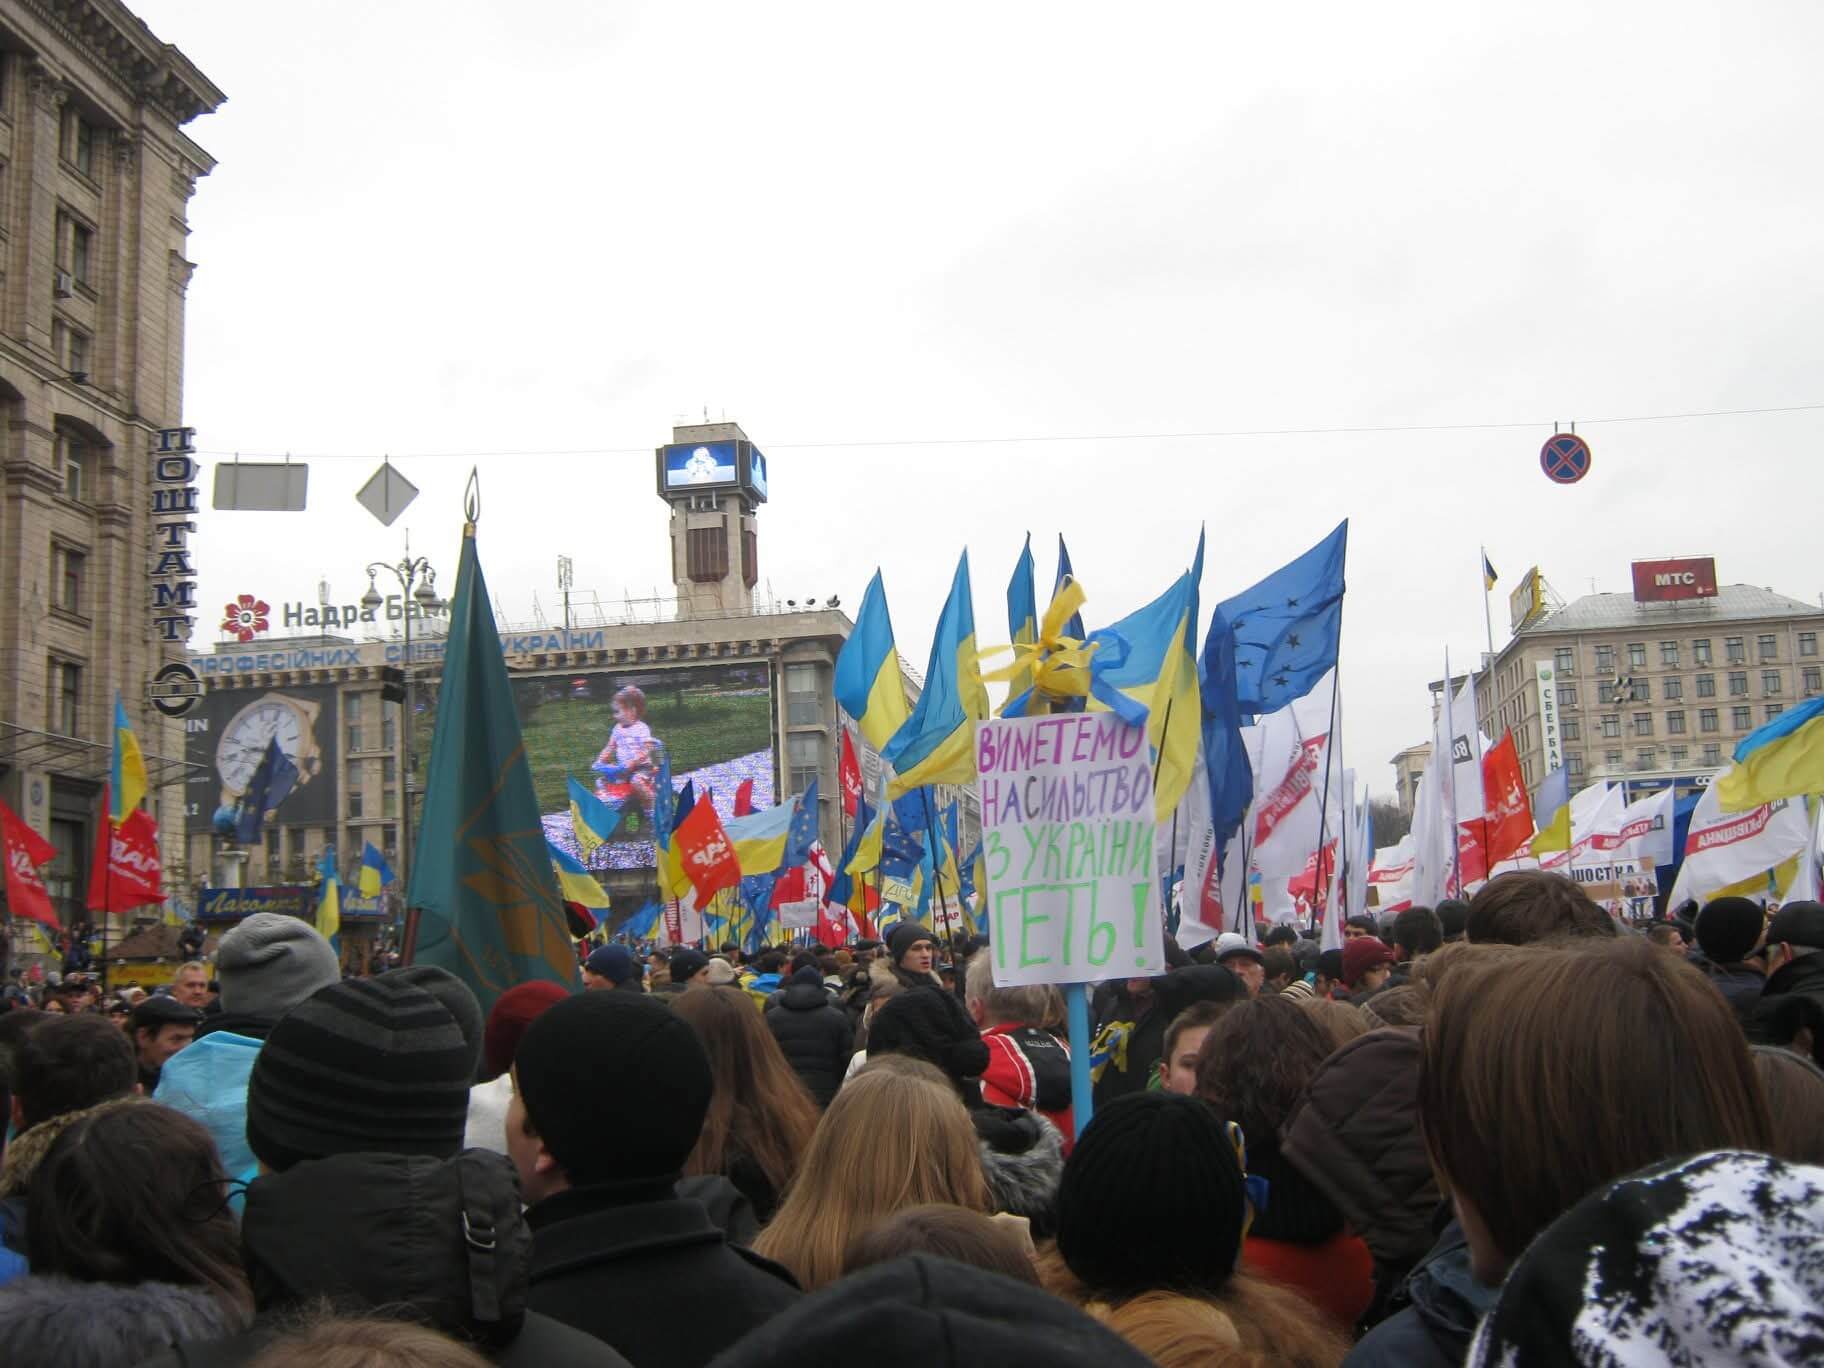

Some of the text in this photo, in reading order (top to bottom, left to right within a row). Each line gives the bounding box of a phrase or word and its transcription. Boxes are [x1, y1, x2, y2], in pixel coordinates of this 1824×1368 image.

[151, 426, 198, 642] ПОШТАМТ
[1655, 571, 1695, 587] МТС
[283, 601, 376, 629] Надра
[978, 717, 1146, 773] ВИМЕТЕМО
[982, 763, 1151, 827] НАСИЛЬСТВО
[986, 830, 1011, 881] З
[1022, 817, 1155, 881] УКРАЇНИ
